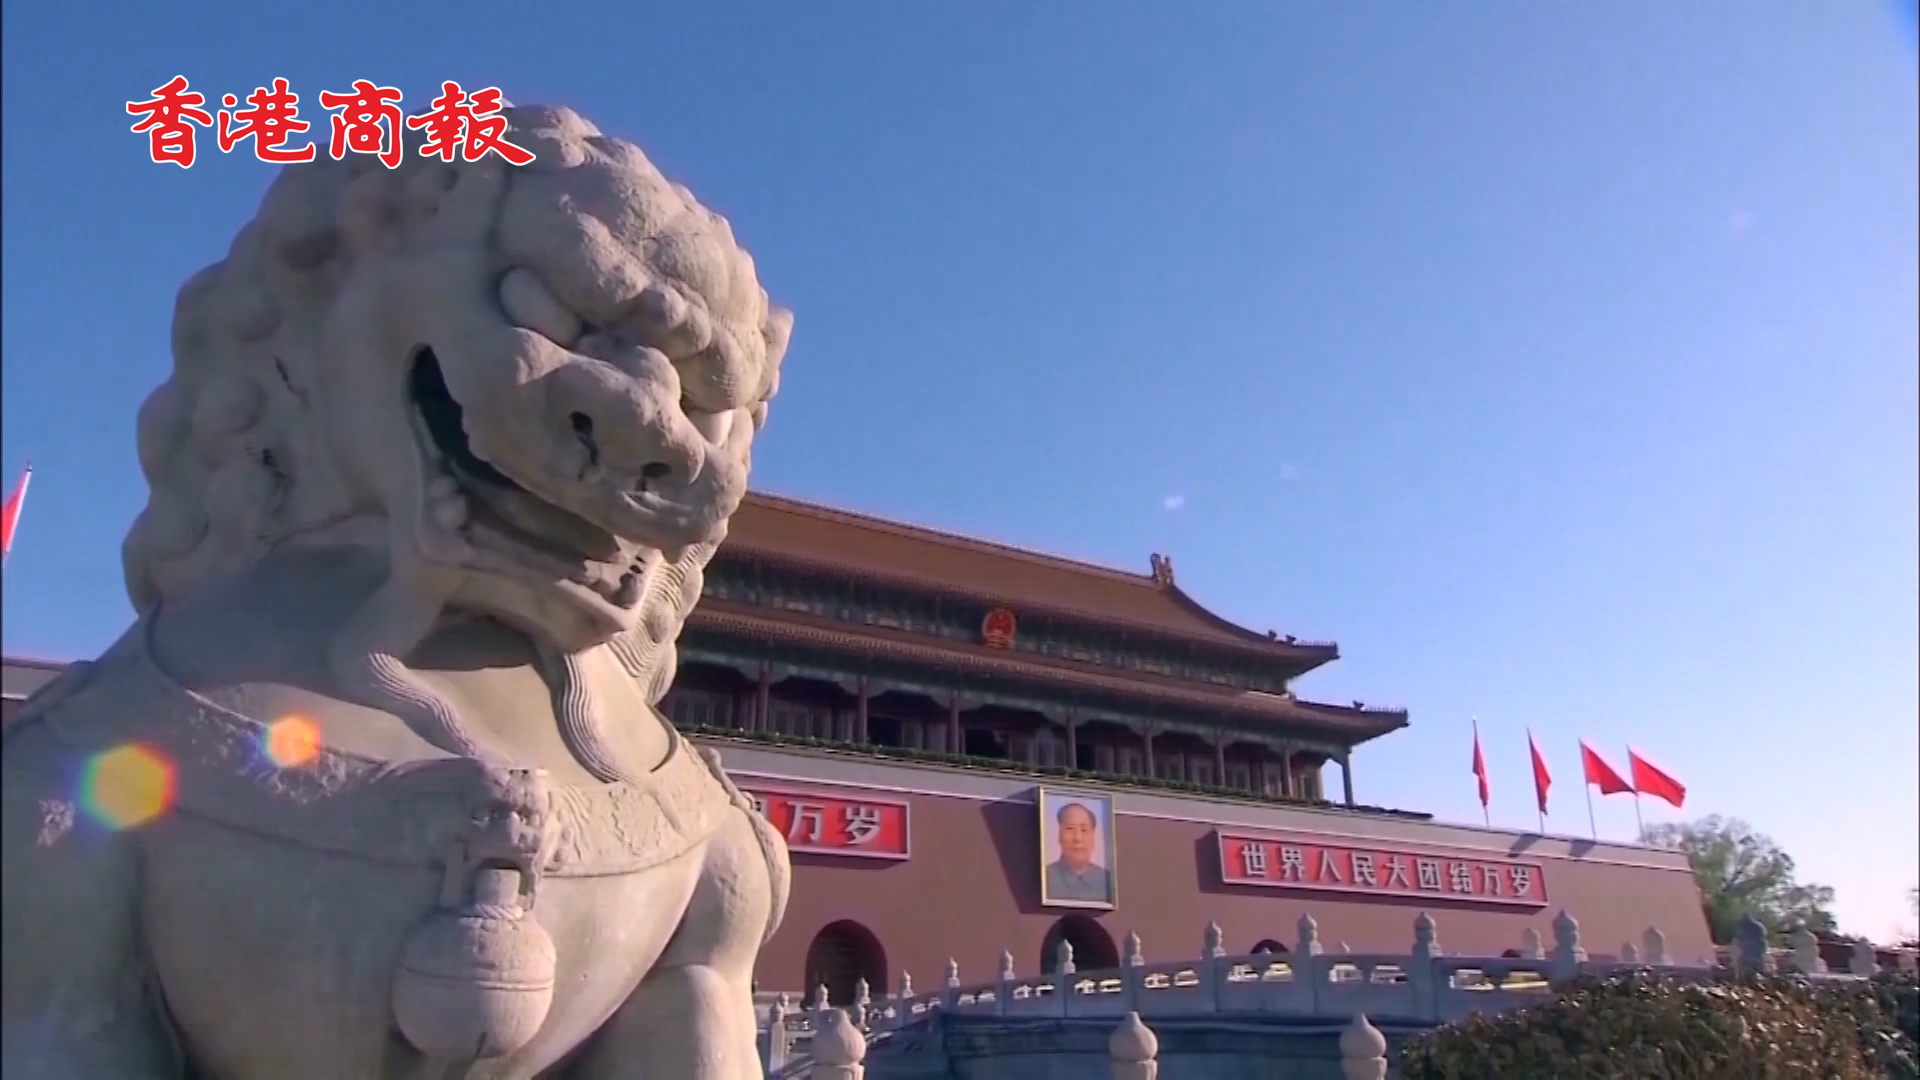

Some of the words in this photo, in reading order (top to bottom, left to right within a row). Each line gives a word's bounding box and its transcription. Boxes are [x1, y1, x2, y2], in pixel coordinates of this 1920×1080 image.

[752, 799, 880, 845] 万岁
[1241, 843, 1531, 897] 世界人民大团结万岁
